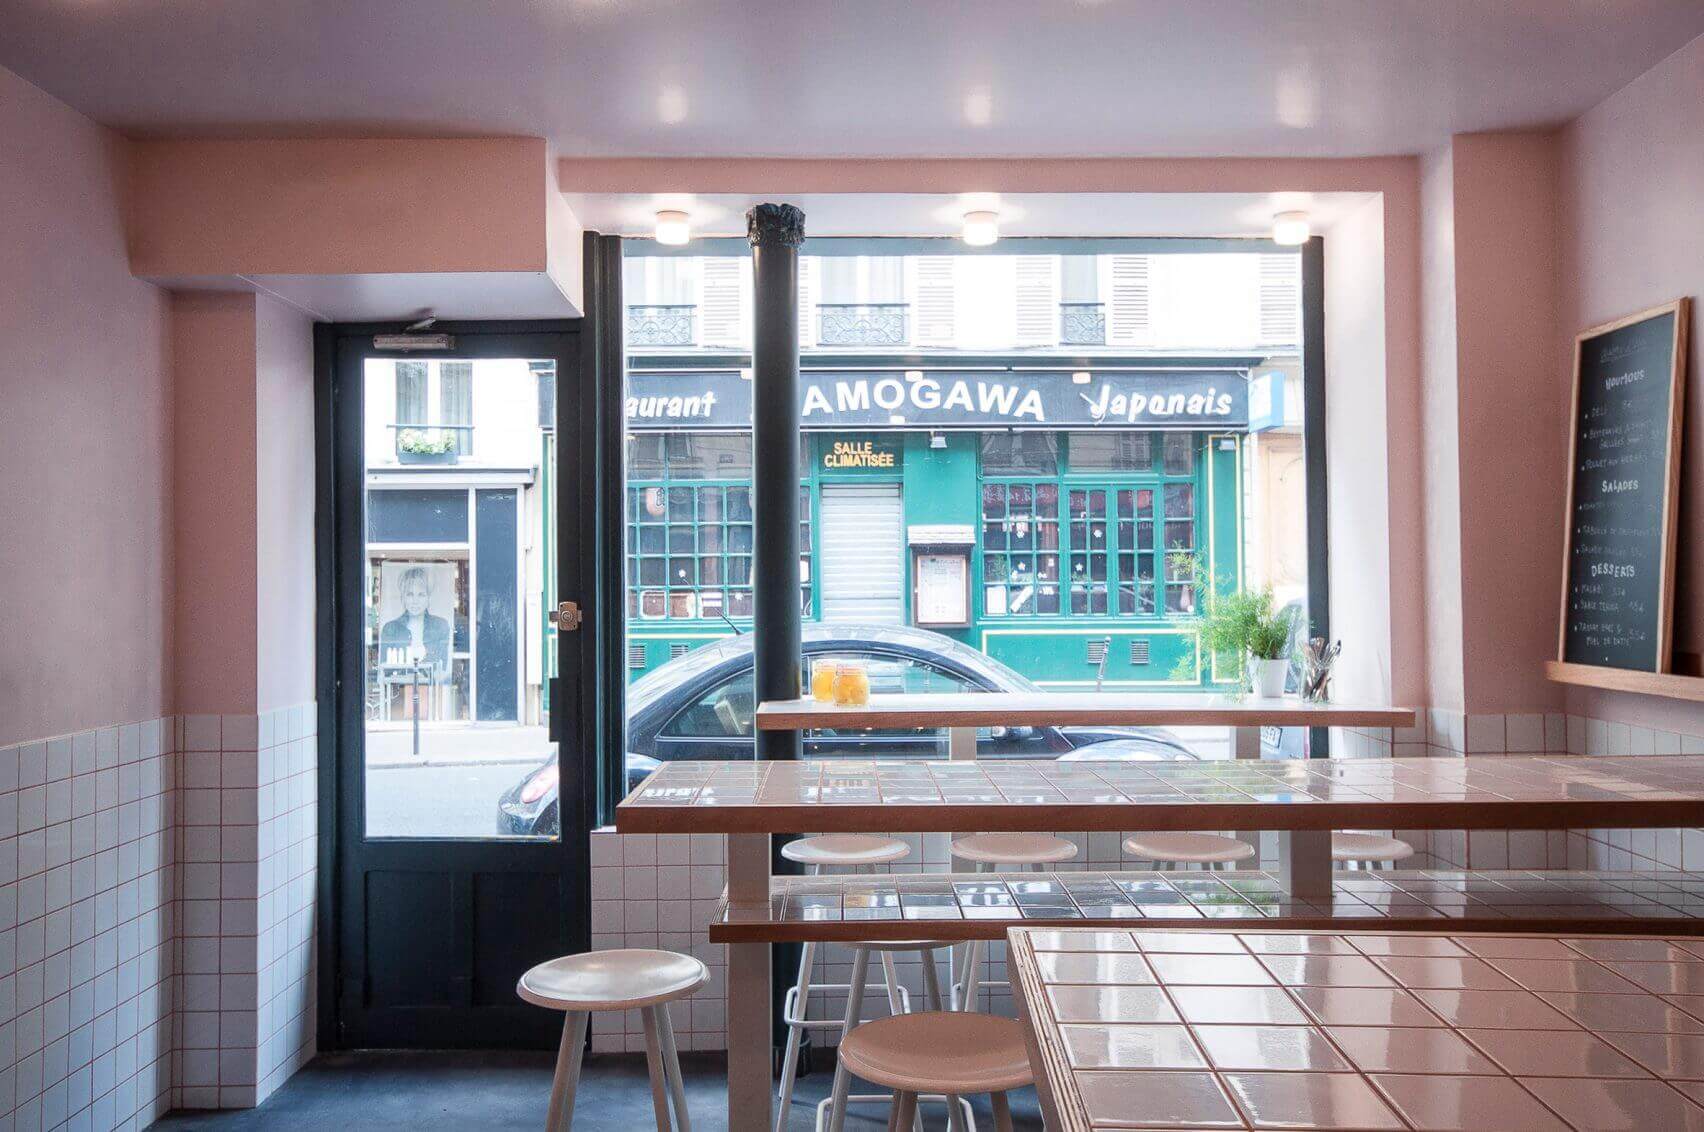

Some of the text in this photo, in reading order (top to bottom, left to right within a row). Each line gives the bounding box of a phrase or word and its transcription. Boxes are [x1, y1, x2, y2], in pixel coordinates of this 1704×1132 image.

[625, 379, 1233, 426] aurant AMOGAWA Japonais
[833, 441, 873, 455] SALLE
[824, 451, 895, 468] CLIMATISÉE
[1601, 479, 1639, 494] SALADES
[1591, 562, 1636, 578] DESSERTS
